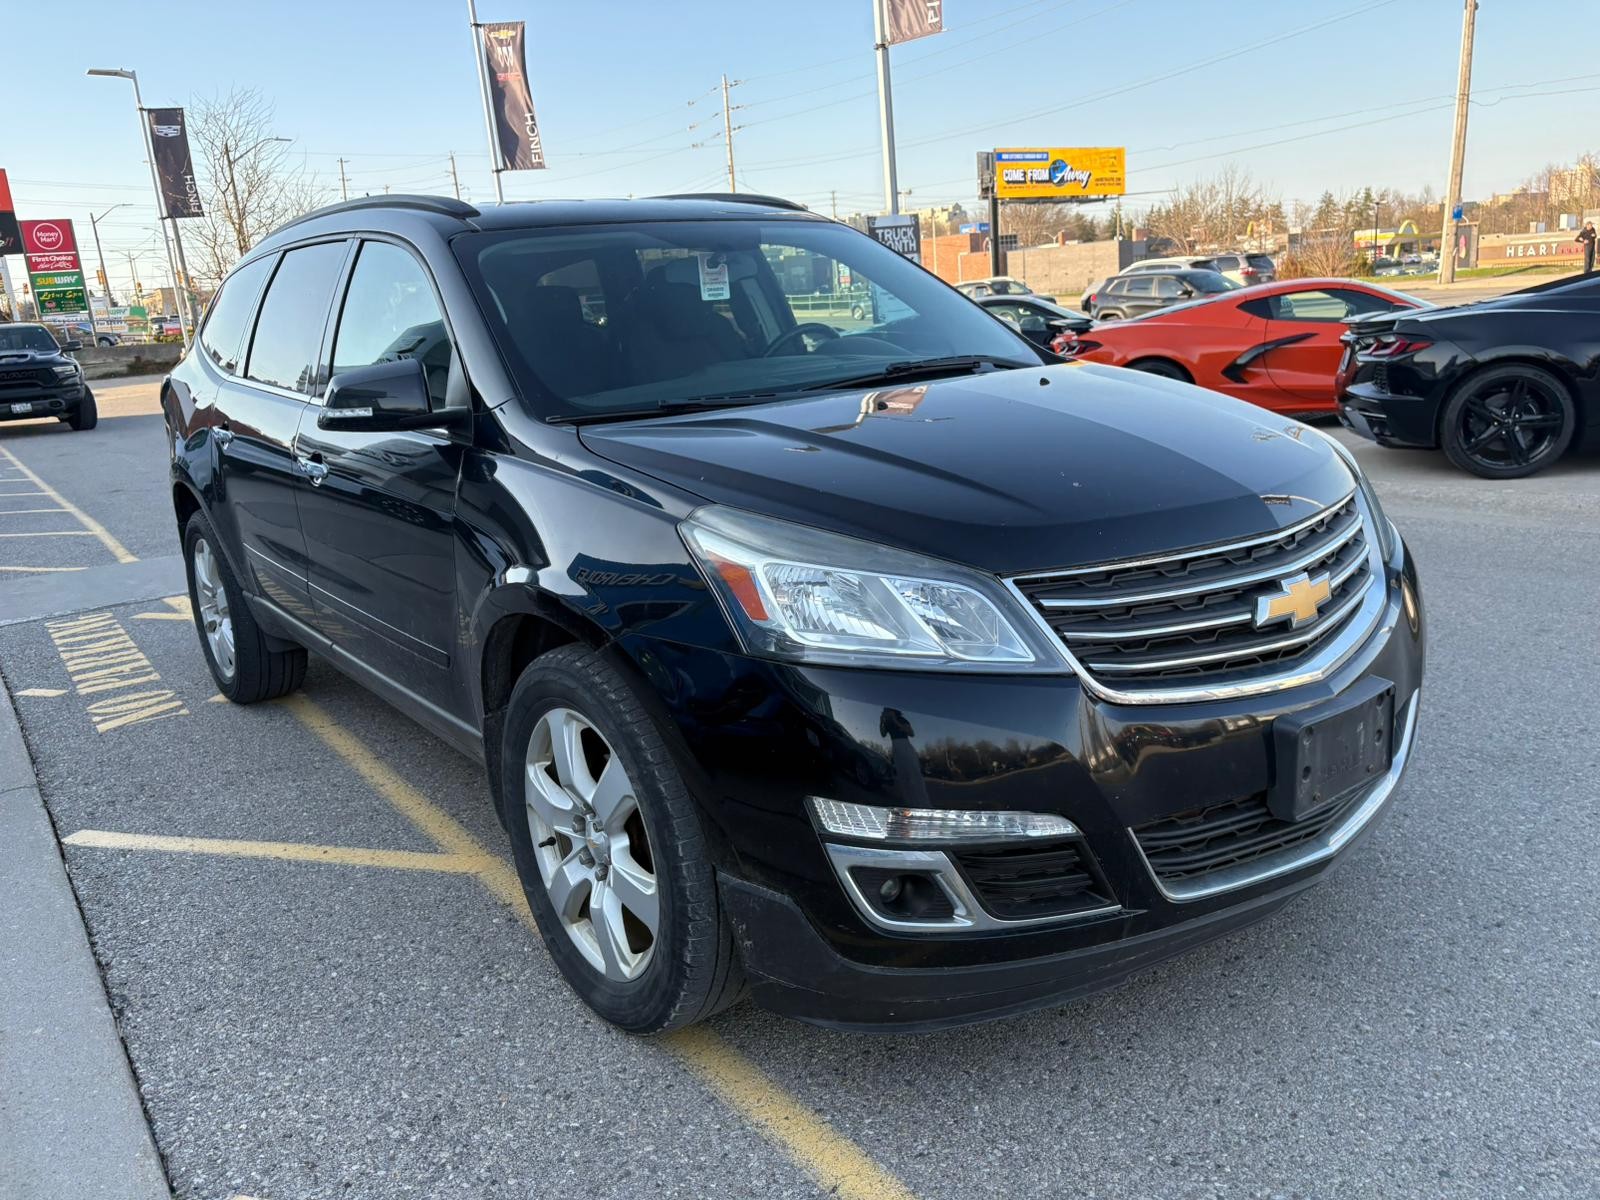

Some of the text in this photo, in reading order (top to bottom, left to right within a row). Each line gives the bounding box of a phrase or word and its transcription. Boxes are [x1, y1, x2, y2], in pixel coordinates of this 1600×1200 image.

[525, 113, 542, 163] FINCH
[1003, 168, 1027, 184] COME
[1028, 168, 1050, 184] FROM
[1050, 164, 1092, 189] Away
[184, 175, 200, 213] FINCH
[36, 231, 59, 239] Money
[875, 226, 916, 242] TRUCK
[881, 239, 917, 252] ONTH
[1506, 243, 1557, 258] HEART
[32, 254, 74, 263] First Choice
[36, 275, 79, 286] SUBWAY
[87, 690, 190, 733] NO
